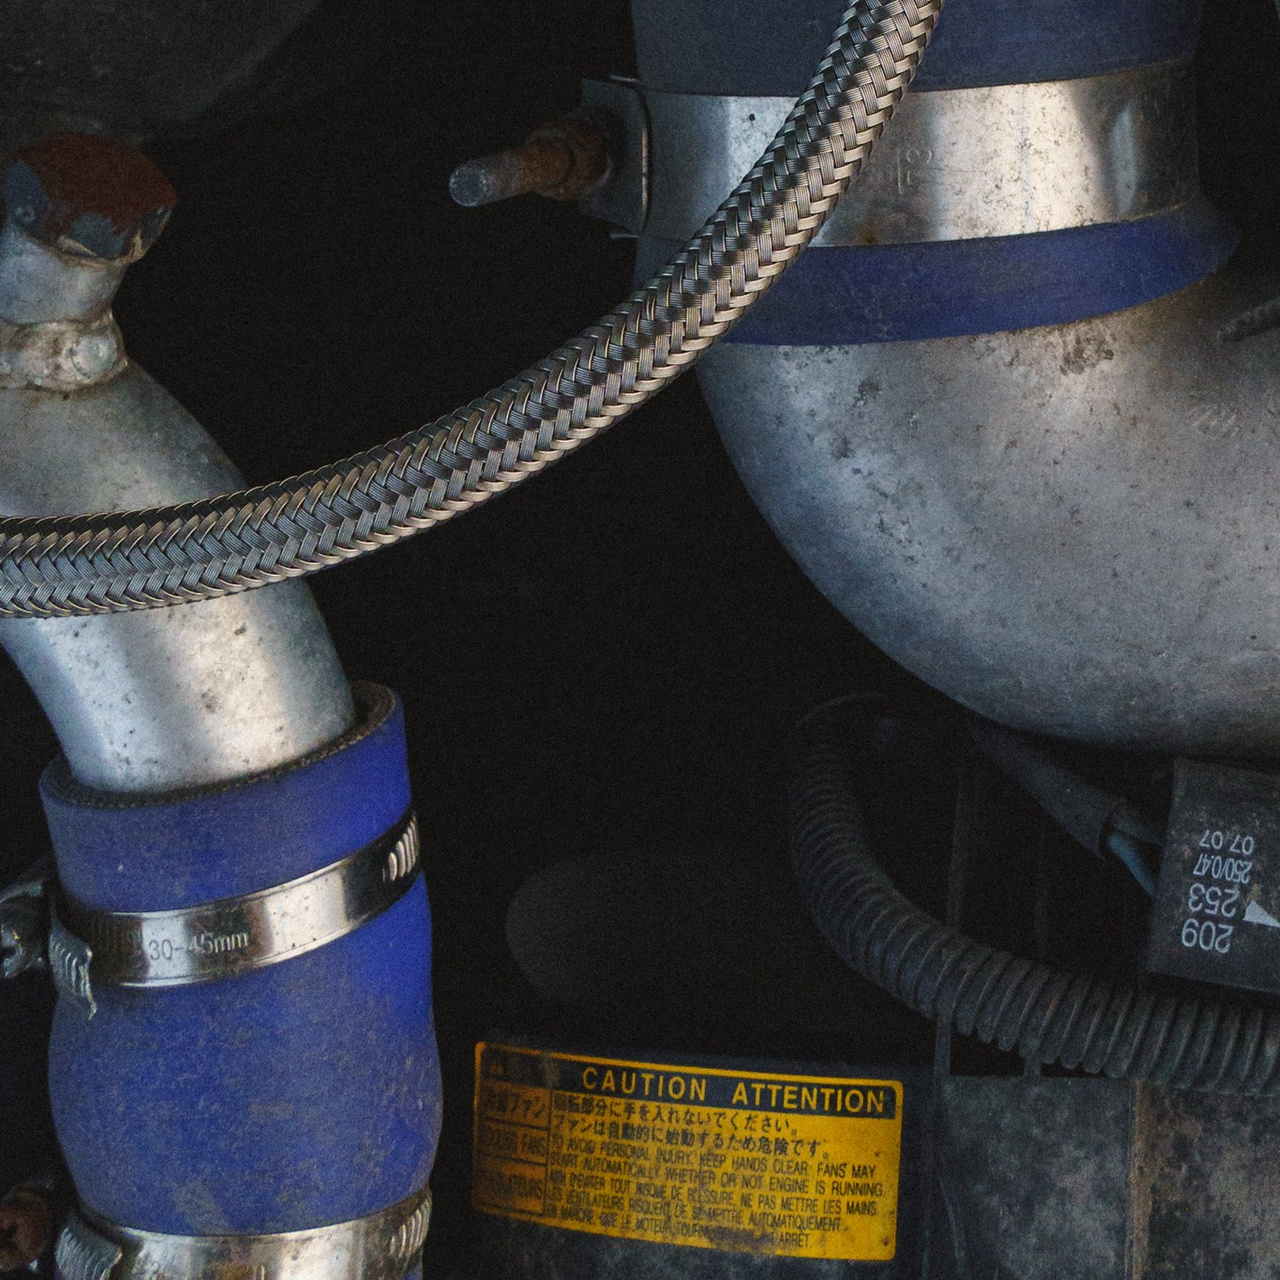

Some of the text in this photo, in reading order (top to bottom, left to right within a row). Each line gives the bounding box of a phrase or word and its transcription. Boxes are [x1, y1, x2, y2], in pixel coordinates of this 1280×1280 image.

[1192, 852, 1253, 885] 250/0.47
[1187, 882, 1240, 919] 253
[148, 931, 250, 961] 30-45mm
[1181, 918, 1235, 954] 209
[582, 1068, 707, 1102] CAUTION
[731, 1081, 886, 1113] ATTENTION
[582, 1158, 659, 1180] AUTOMATICALLY
[665, 1167, 716, 1184] WHETHER
[720, 1172, 736, 1187] OR
[741, 1174, 763, 1190] NOT
[769, 1176, 809, 1194] ENGINE
[815, 1180, 826, 1195] IS
[699, 1152, 727, 1168] KEEP
[732, 1156, 768, 1173] HANDS
[817, 1162, 847, 1178] FANS
[852, 1164, 877, 1179] MAY
[740, 1192, 753, 1207] NE
[757, 1194, 777, 1210] PAS
[780, 1196, 818, 1214] METTRE
[846, 1201, 877, 1217] MAINS
